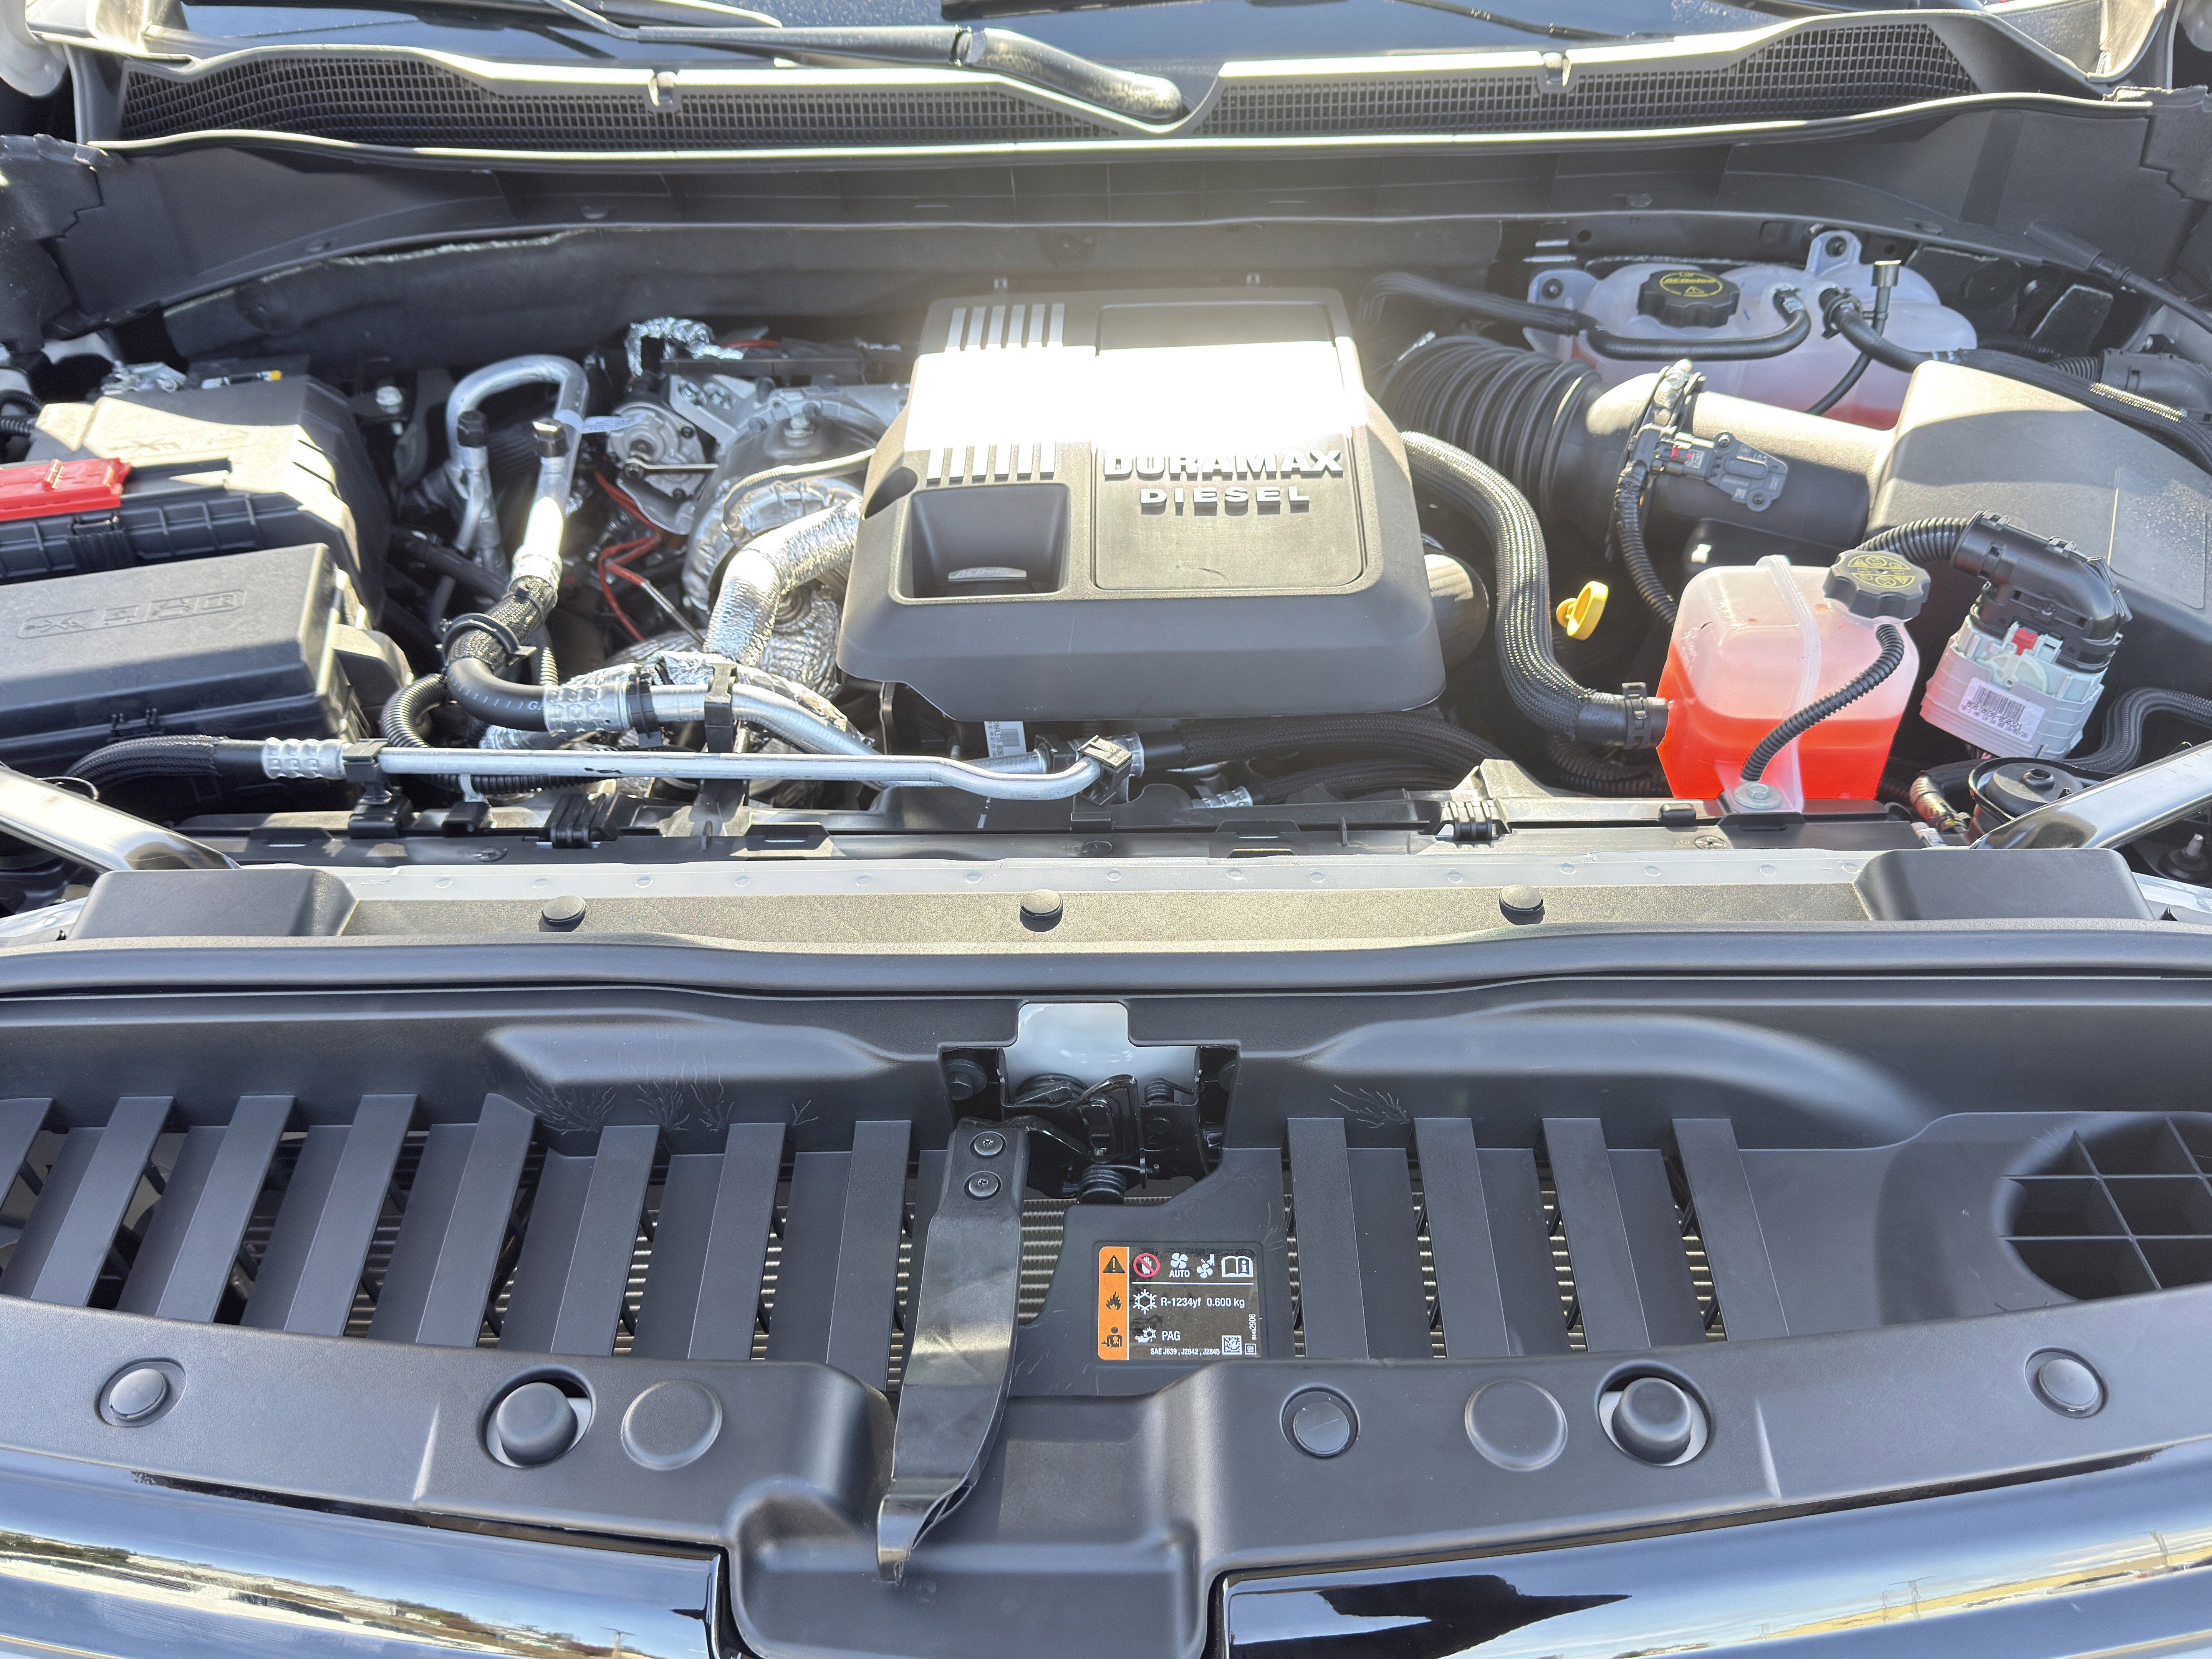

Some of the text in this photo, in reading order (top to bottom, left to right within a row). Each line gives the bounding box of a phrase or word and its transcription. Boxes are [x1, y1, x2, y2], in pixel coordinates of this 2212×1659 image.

[1104, 449, 1343, 479] DURAMAX
[1141, 486, 1310, 506] DIESEL
[1169, 1270, 1190, 1278] AUTO
[1161, 1297, 1245, 1308] R-1234yf 0.600 kg
[1162, 1330, 1181, 1341] PAG
